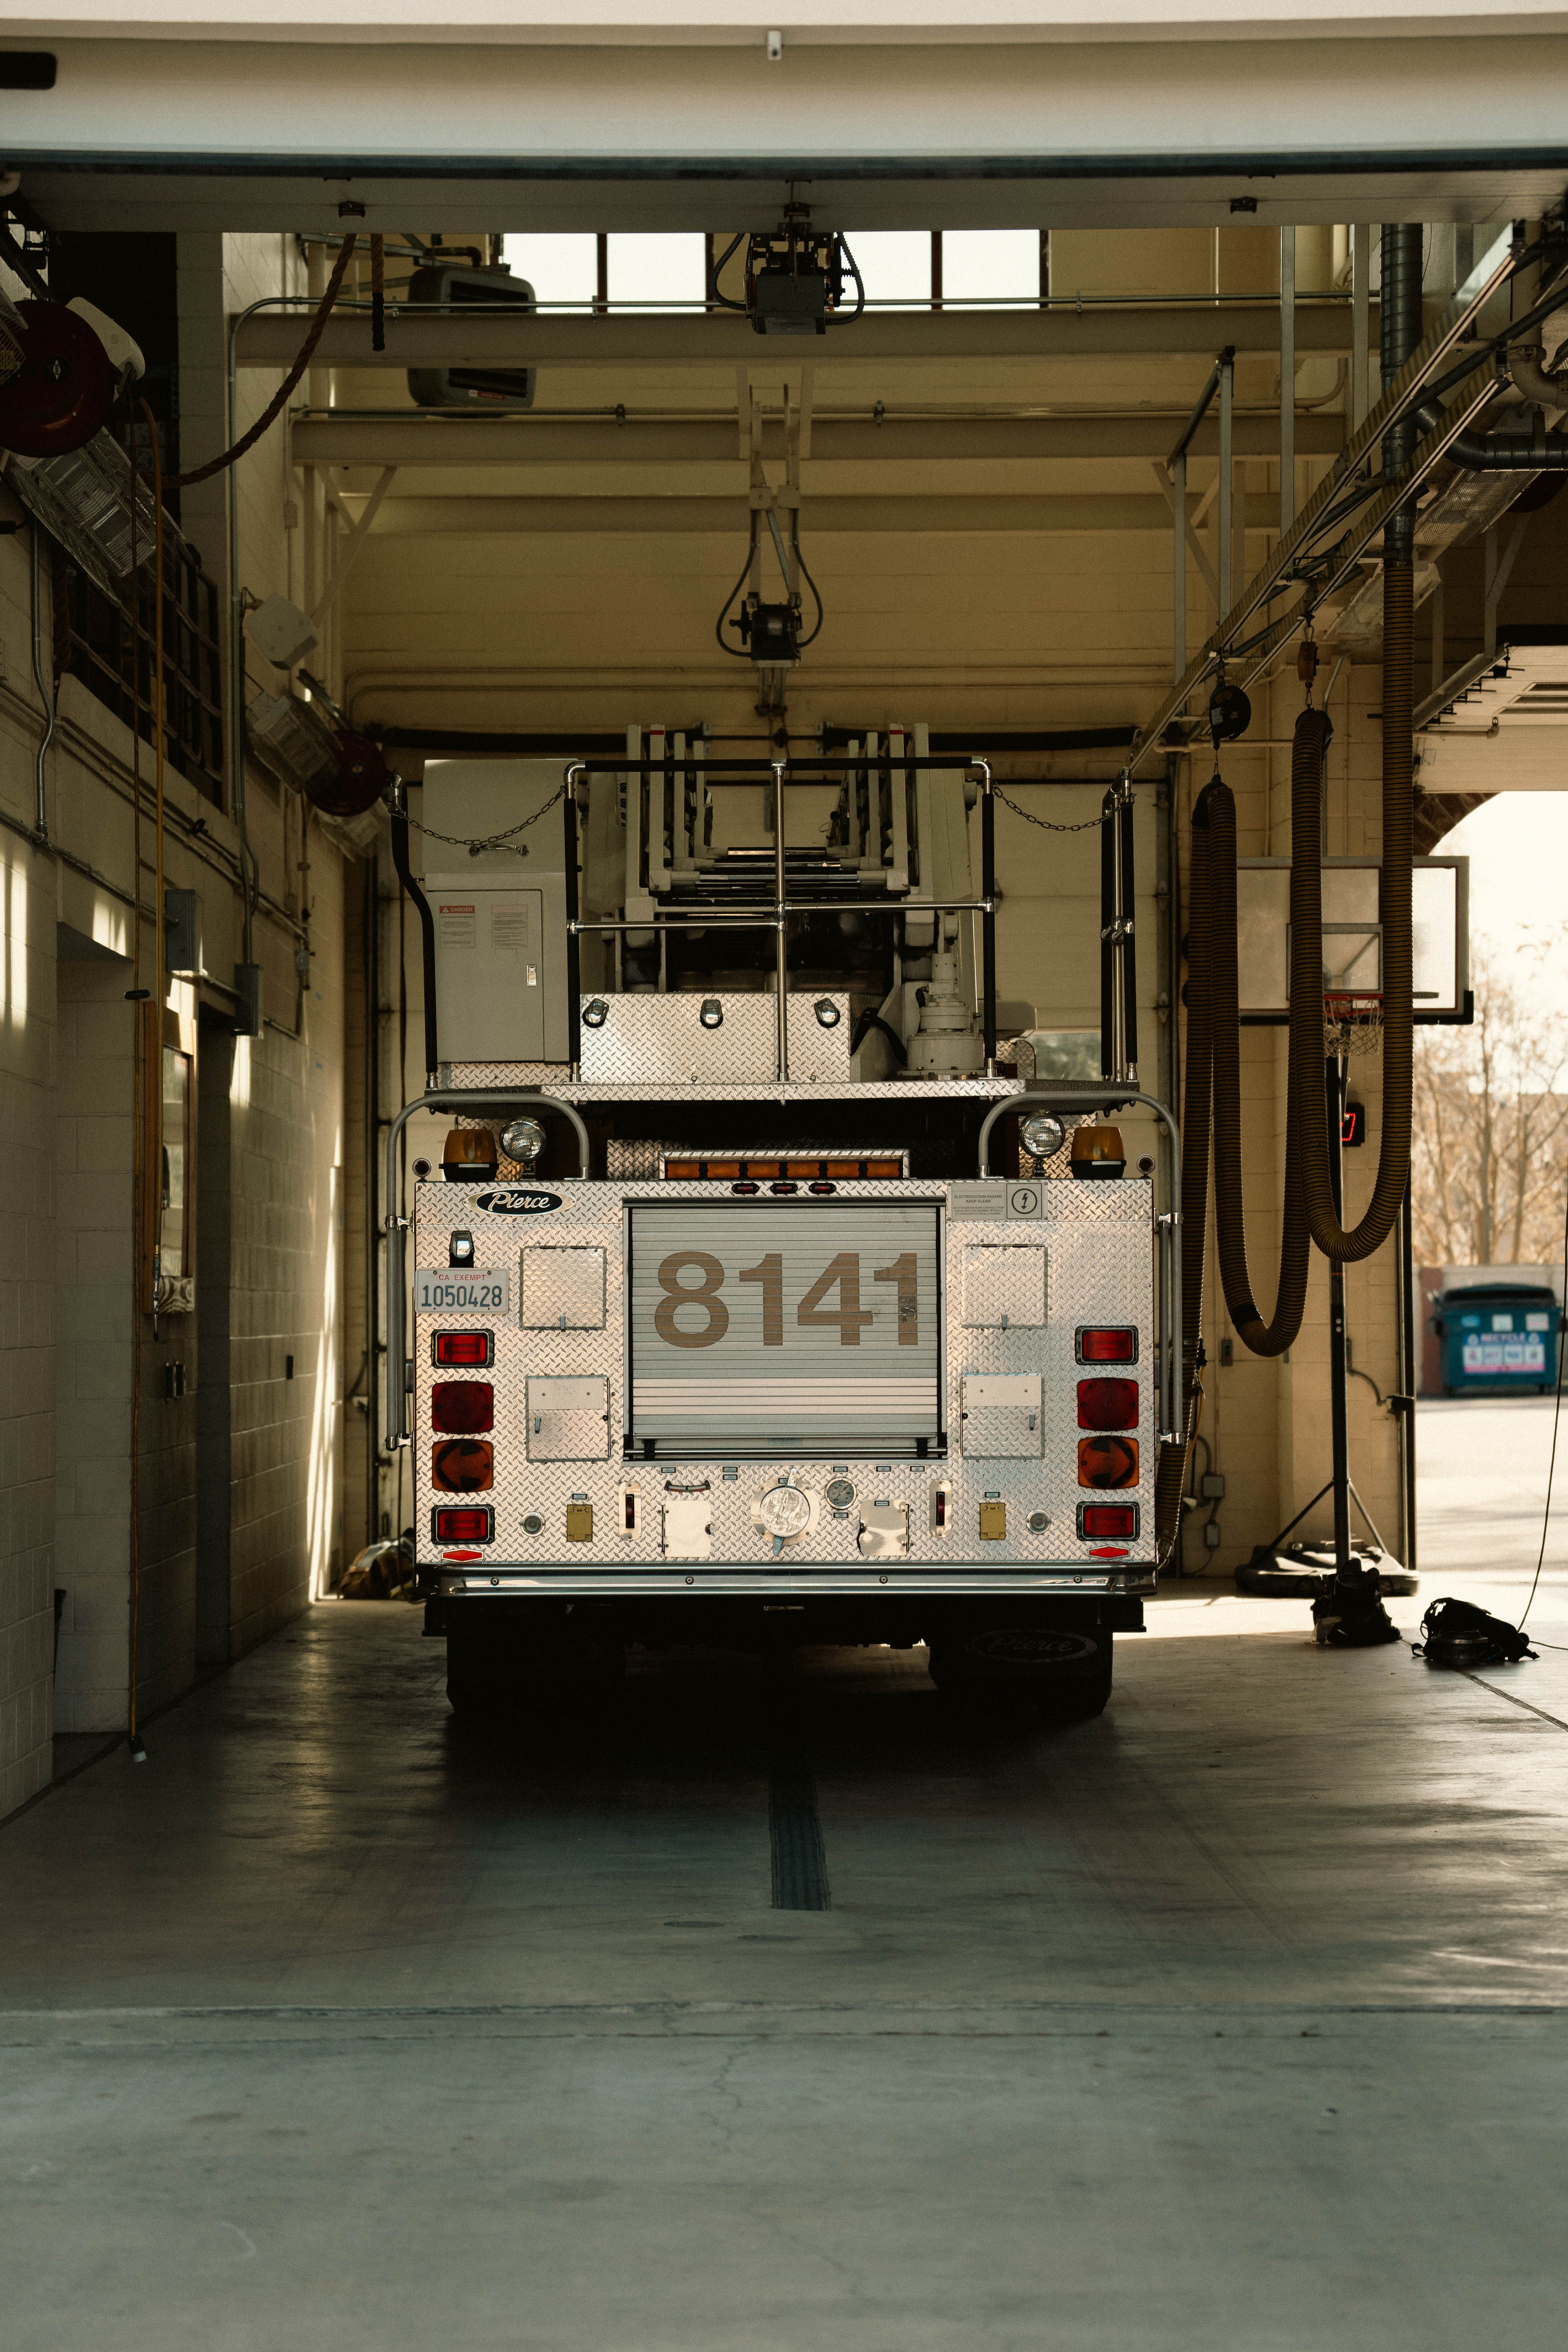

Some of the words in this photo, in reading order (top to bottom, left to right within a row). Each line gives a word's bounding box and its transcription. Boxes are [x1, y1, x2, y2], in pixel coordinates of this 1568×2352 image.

[488, 1192, 550, 1211] Pierce
[422, 1285, 502, 1307] 1050428
[655, 1251, 918, 1348] 8141
